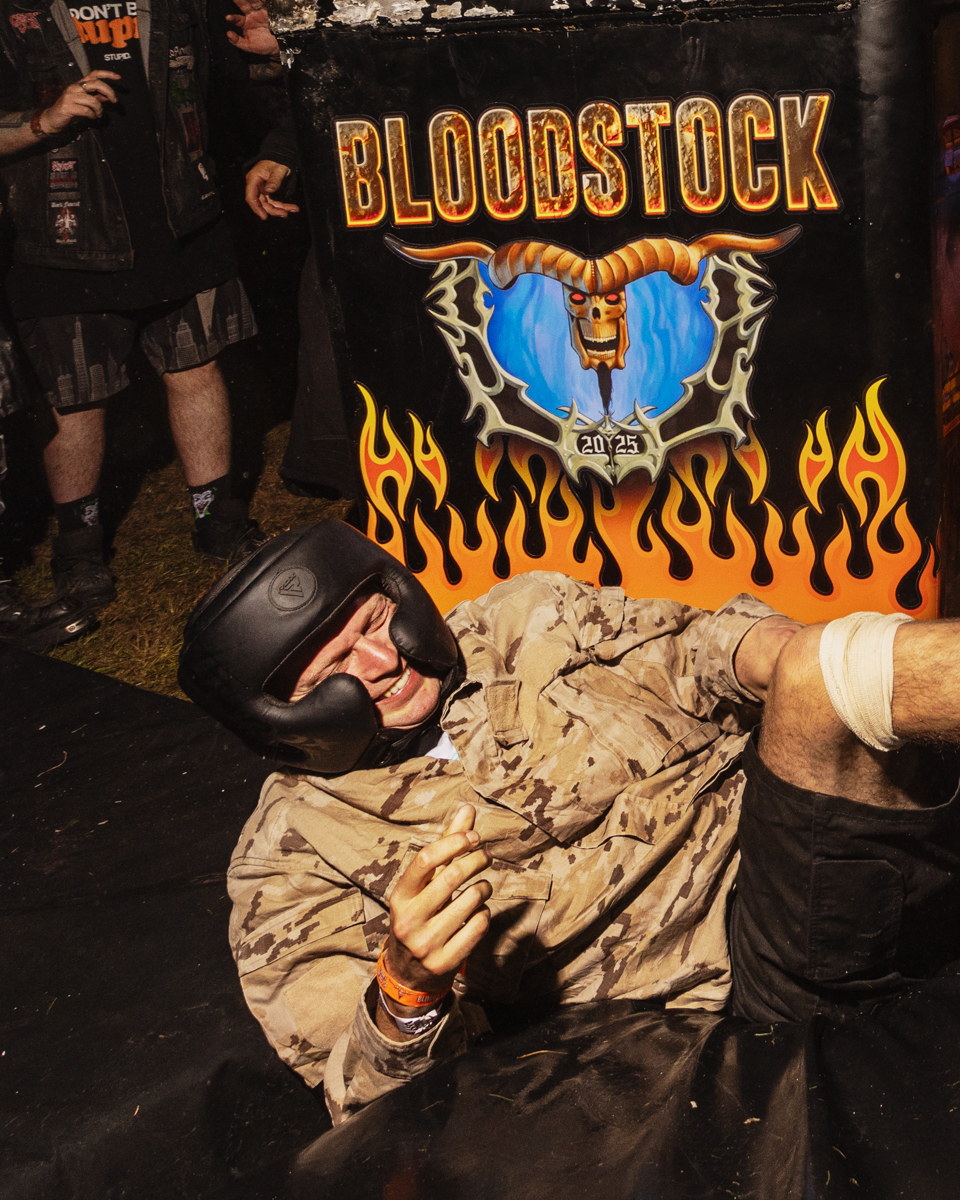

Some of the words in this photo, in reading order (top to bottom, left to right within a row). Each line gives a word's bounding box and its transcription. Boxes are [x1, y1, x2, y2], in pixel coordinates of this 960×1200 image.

[69, 3, 122, 20] DON'T
[125, 1, 137, 16] B
[335, 94, 840, 228] BLOODSTOCK
[581, 434, 606, 454] 20
[615, 434, 640, 454] 25
